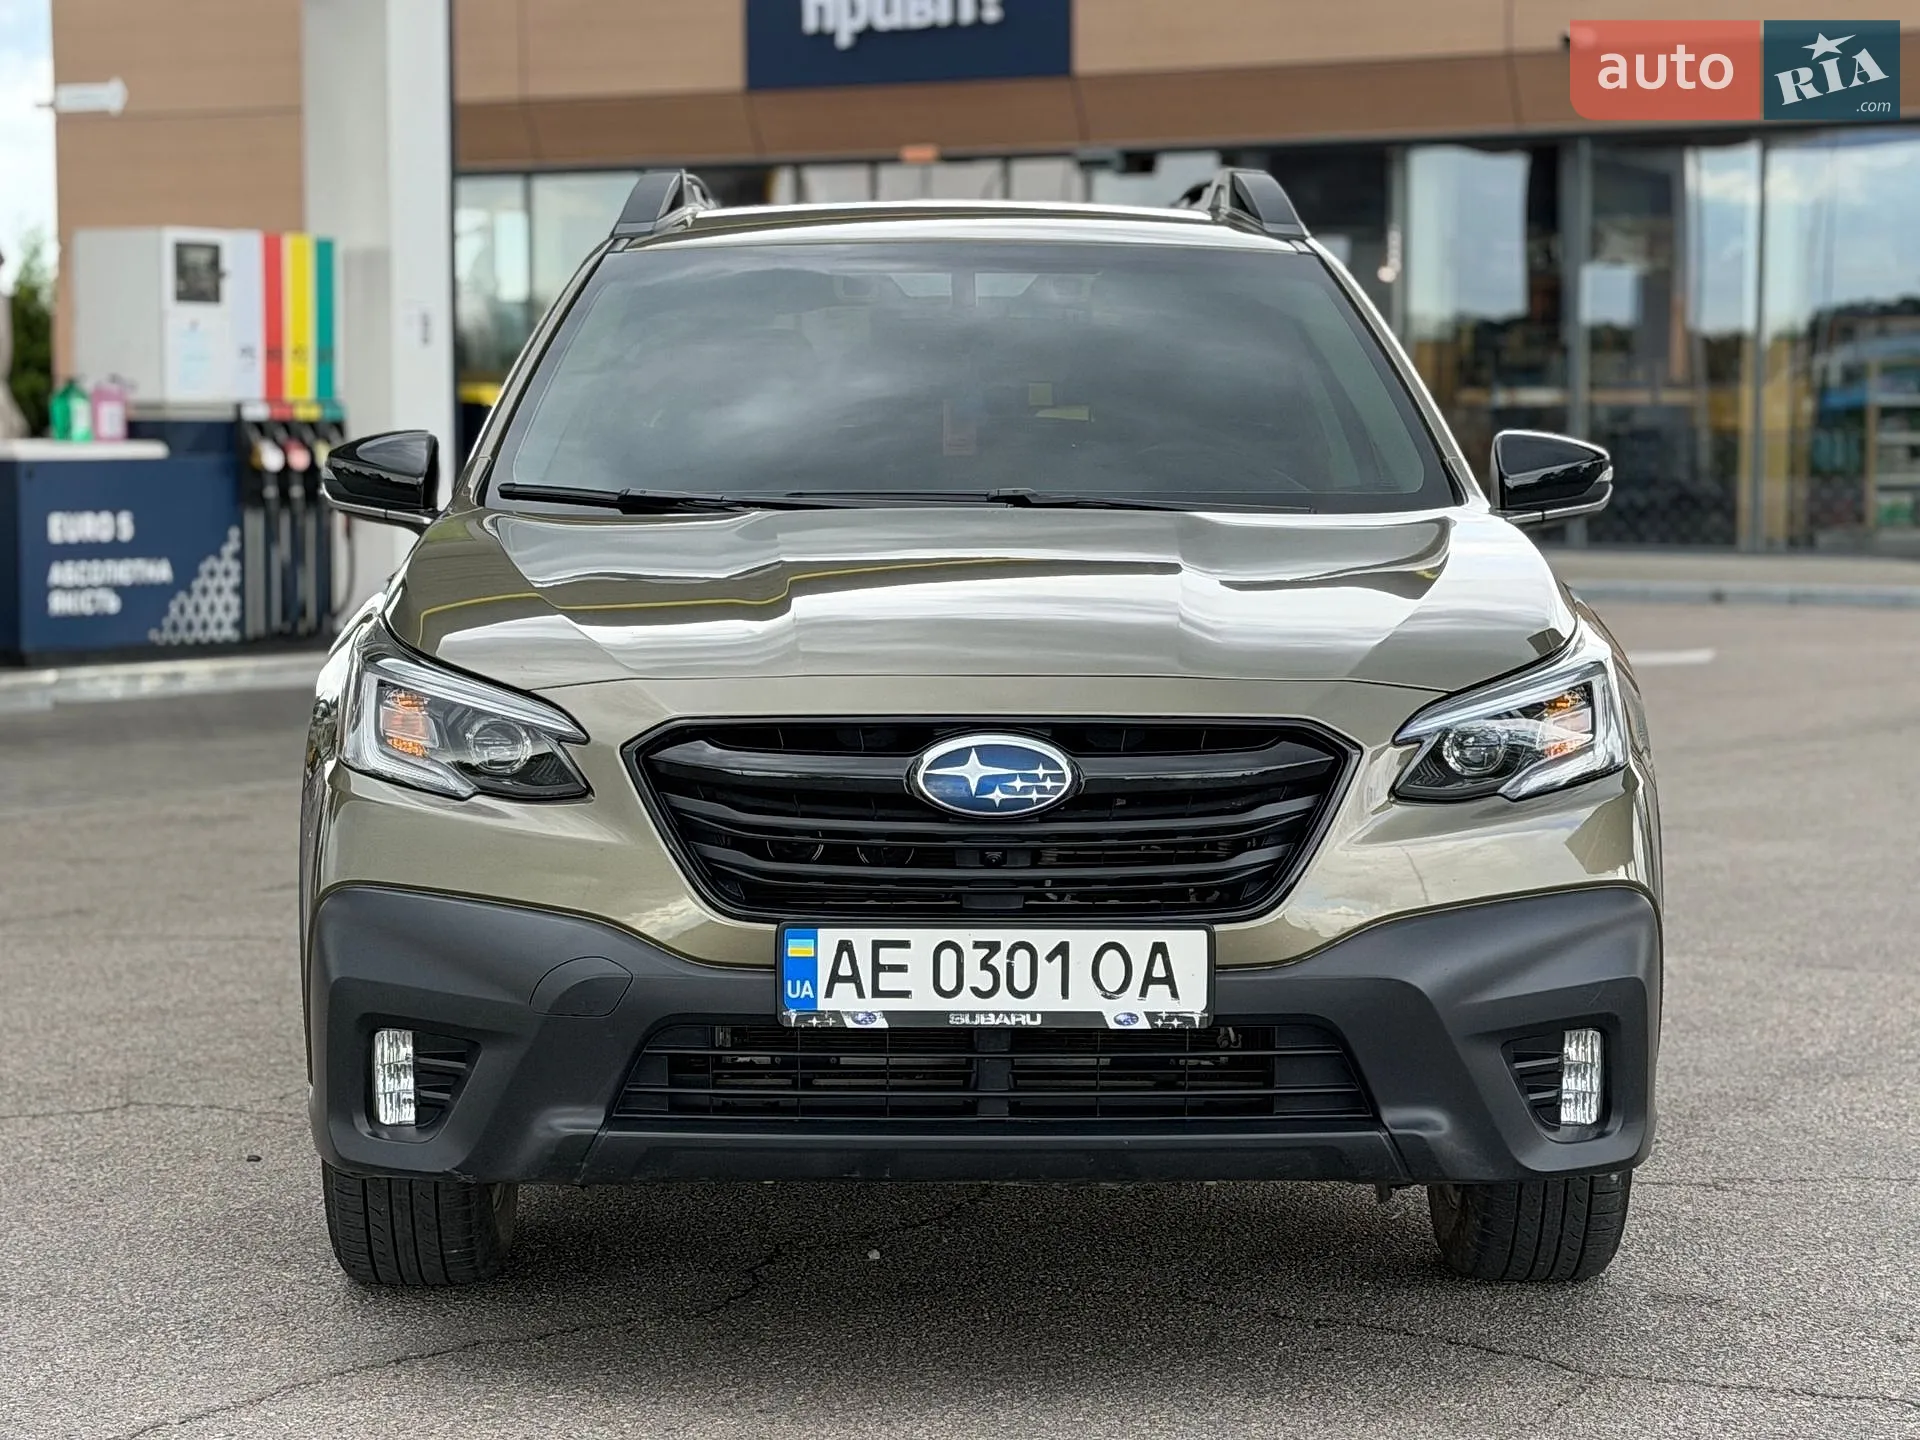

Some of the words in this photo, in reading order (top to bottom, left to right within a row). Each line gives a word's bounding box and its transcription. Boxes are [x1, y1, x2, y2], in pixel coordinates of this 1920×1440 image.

[47, 510, 115, 544] EURO
[116, 510, 134, 542] 5
[47, 557, 173, 587] АБСОЛЮТНА
[824, 940, 912, 999] AE
[932, 940, 1069, 1000] 0301
[1091, 941, 1181, 1001] OA
[787, 980, 814, 999] UA
[948, 1012, 1042, 1025] SUBARU
